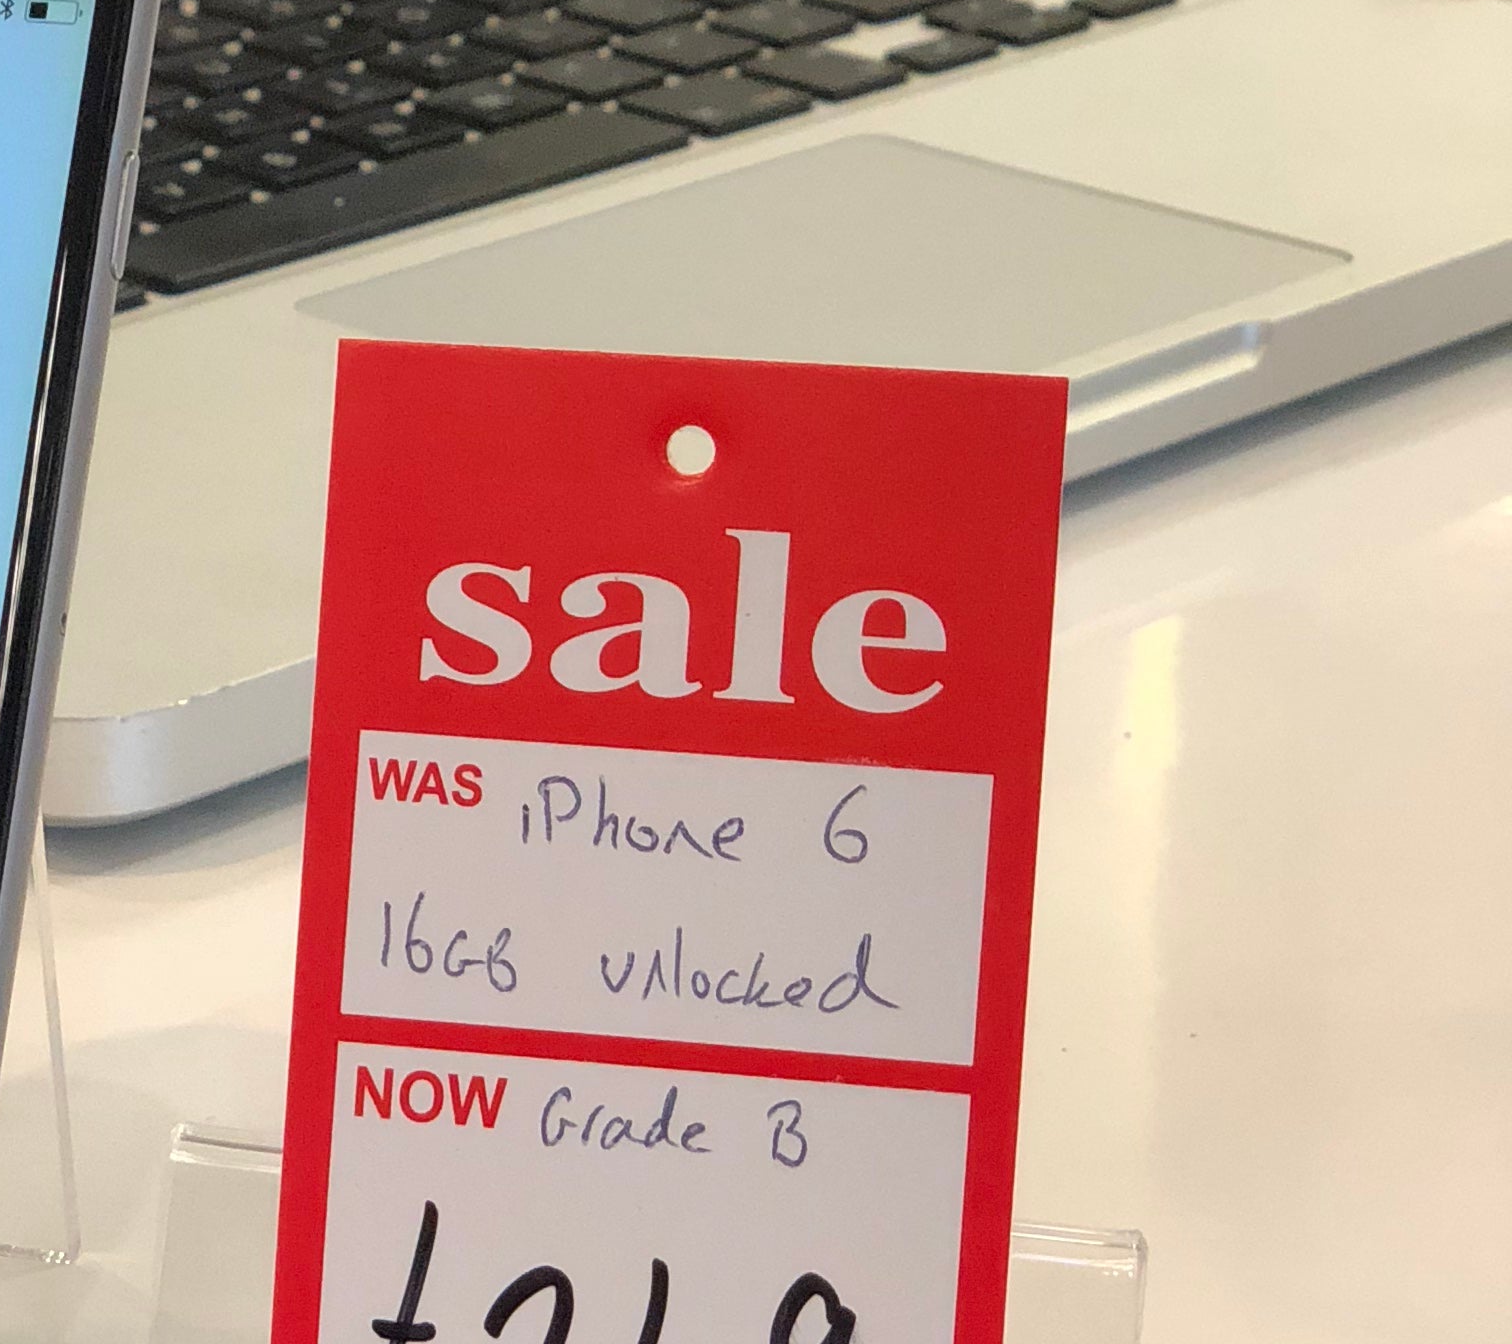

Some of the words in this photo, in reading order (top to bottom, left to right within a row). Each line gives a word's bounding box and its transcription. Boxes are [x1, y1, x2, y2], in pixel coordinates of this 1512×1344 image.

[419, 527, 948, 714] sale
[368, 757, 484, 808] WAS
[521, 774, 745, 862] iPhone
[822, 783, 870, 864] 6
[382, 891, 518, 992] 16GB
[352, 1065, 508, 1130] NOW
[540, 1086, 711, 1155] Grade
[764, 1098, 809, 1167] B
